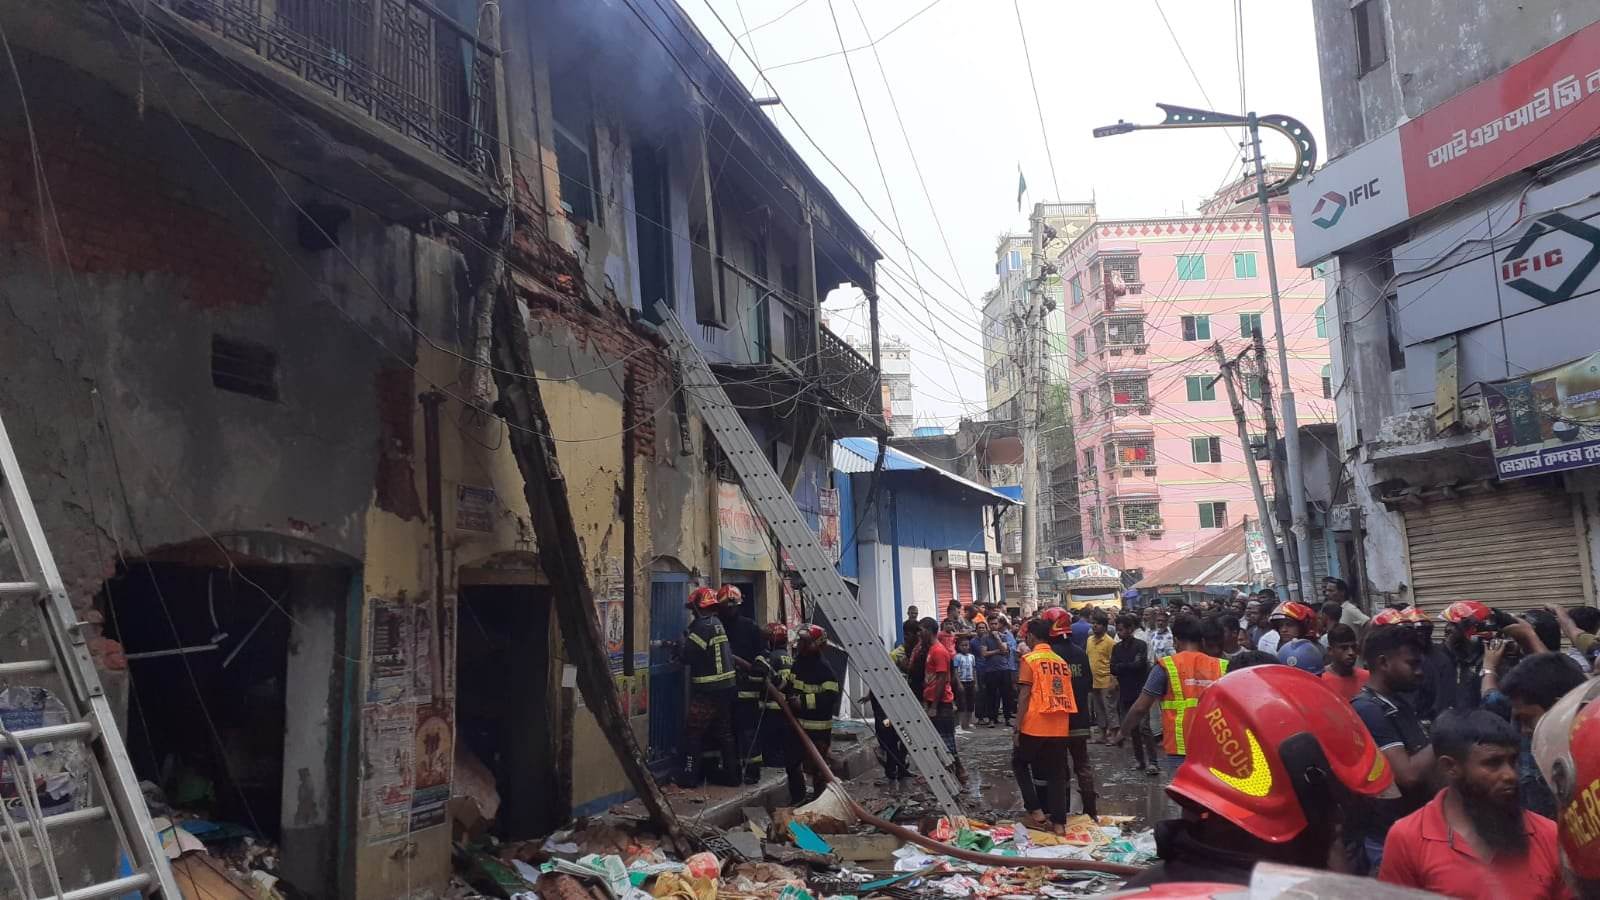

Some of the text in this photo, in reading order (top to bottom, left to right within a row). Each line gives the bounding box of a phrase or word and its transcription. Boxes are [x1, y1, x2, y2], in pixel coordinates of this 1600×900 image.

[1348, 177, 1381, 207] IFIC
[1502, 248, 1563, 280] IFIC
[1040, 661, 1069, 676] FIRE
